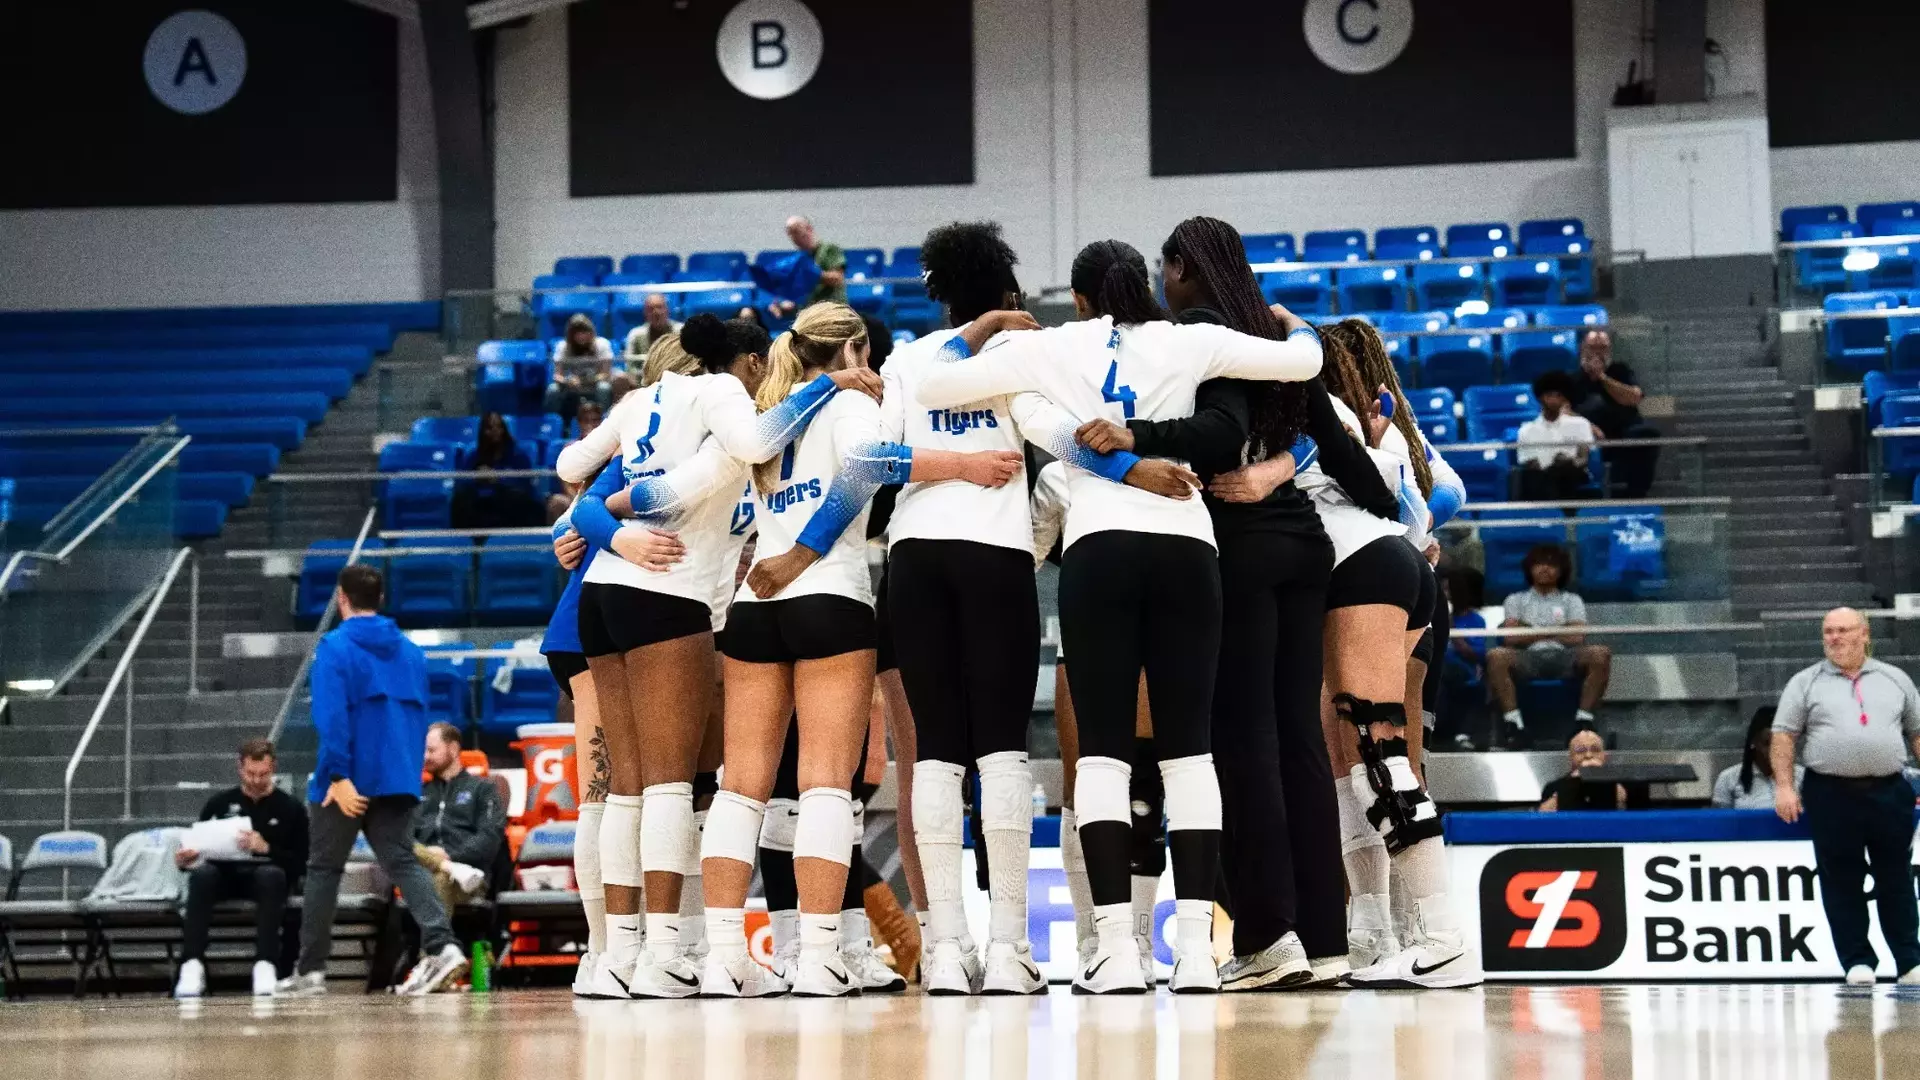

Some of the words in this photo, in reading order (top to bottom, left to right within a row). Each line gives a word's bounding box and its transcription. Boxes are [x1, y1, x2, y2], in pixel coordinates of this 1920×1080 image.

[751, 20, 788, 69] B
[1336, 0, 1379, 44] C
[173, 37, 217, 86] A
[1101, 359, 1137, 419] 4
[927, 408, 999, 435] Tigers
[766, 478, 822, 514] igers
[533, 748, 564, 783] G
[1645, 913, 1818, 963] Bank
